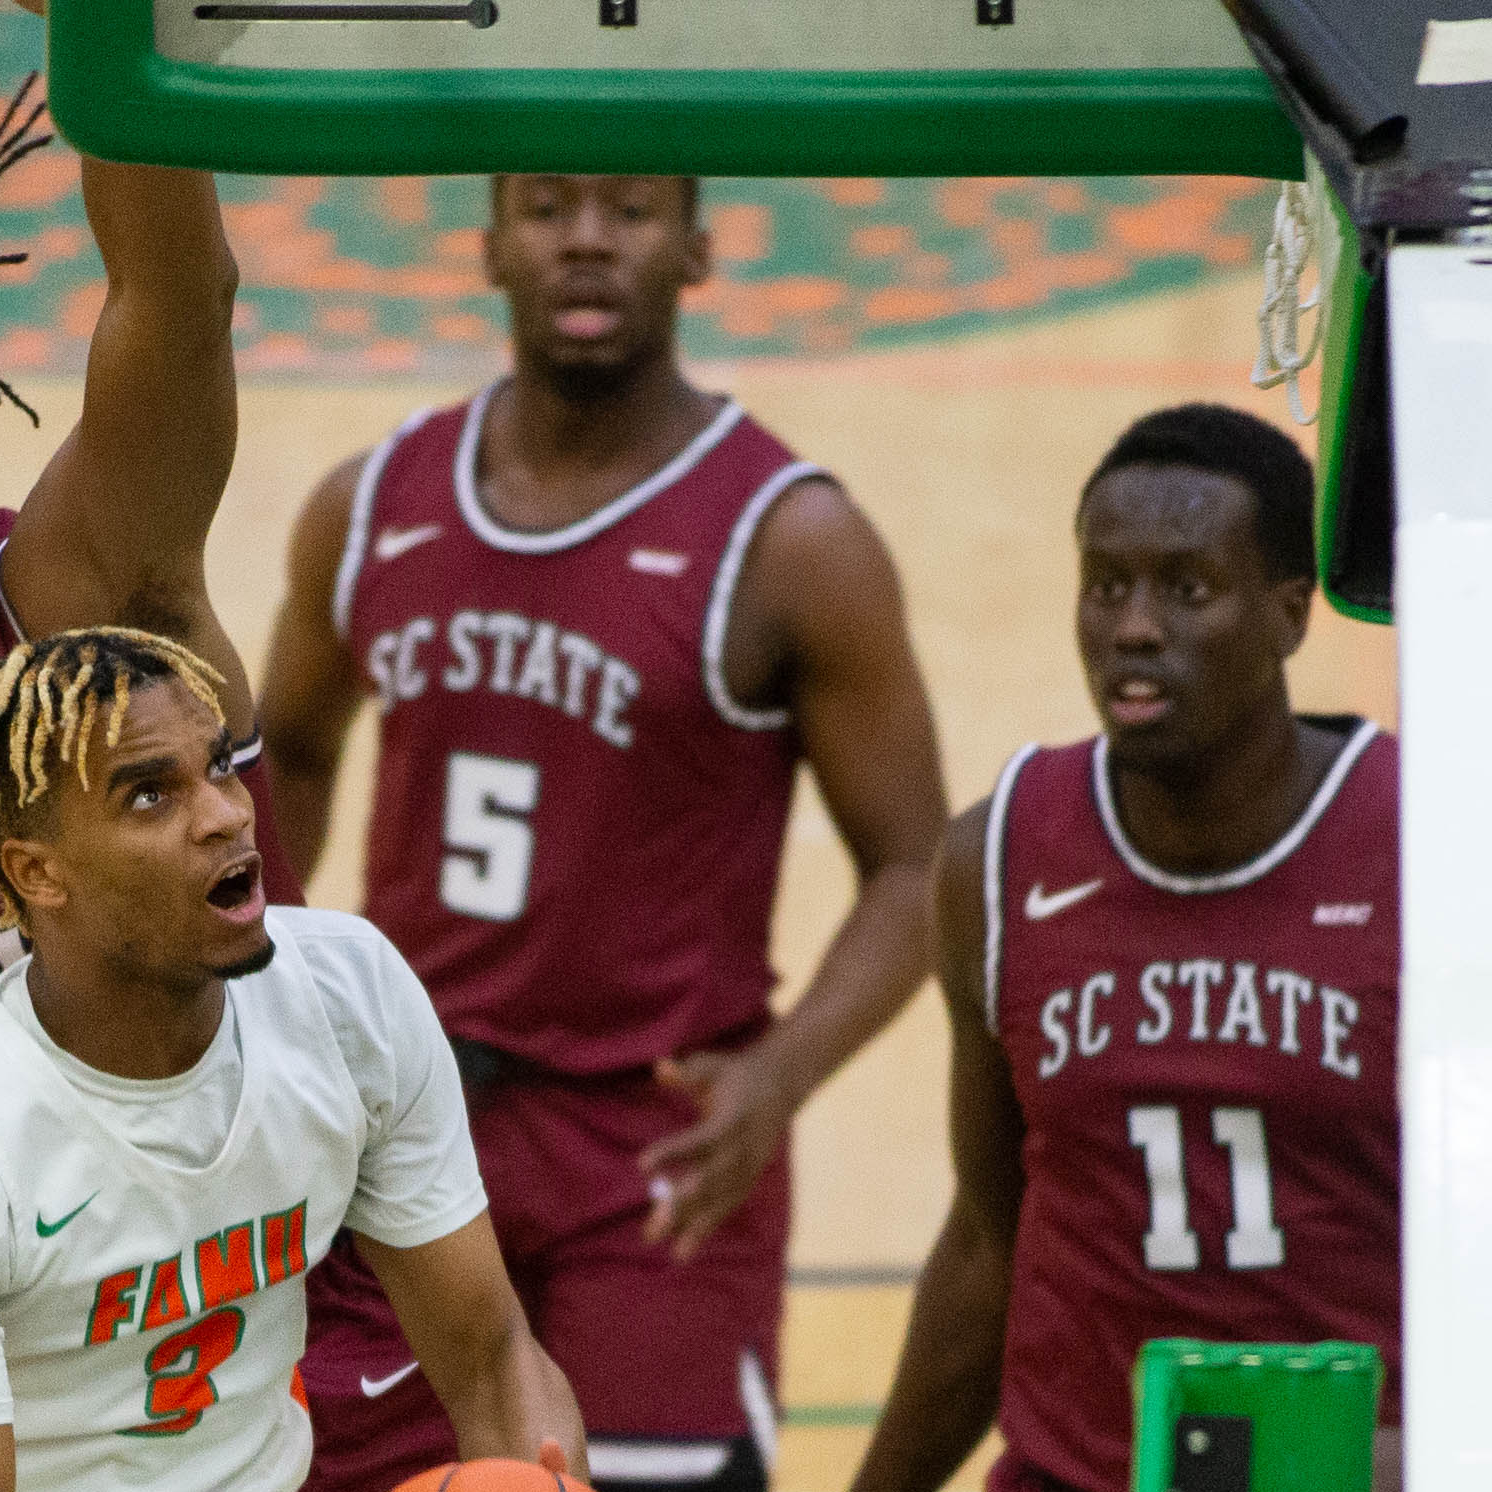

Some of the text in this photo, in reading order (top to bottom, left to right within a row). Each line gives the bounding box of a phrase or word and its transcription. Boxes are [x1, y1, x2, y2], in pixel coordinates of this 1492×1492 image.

[368, 608, 642, 750] SC STATE
[439, 749, 542, 922] 5
[1037, 957, 1363, 1082] SC STATE
[1126, 1103, 1287, 1272] 11
